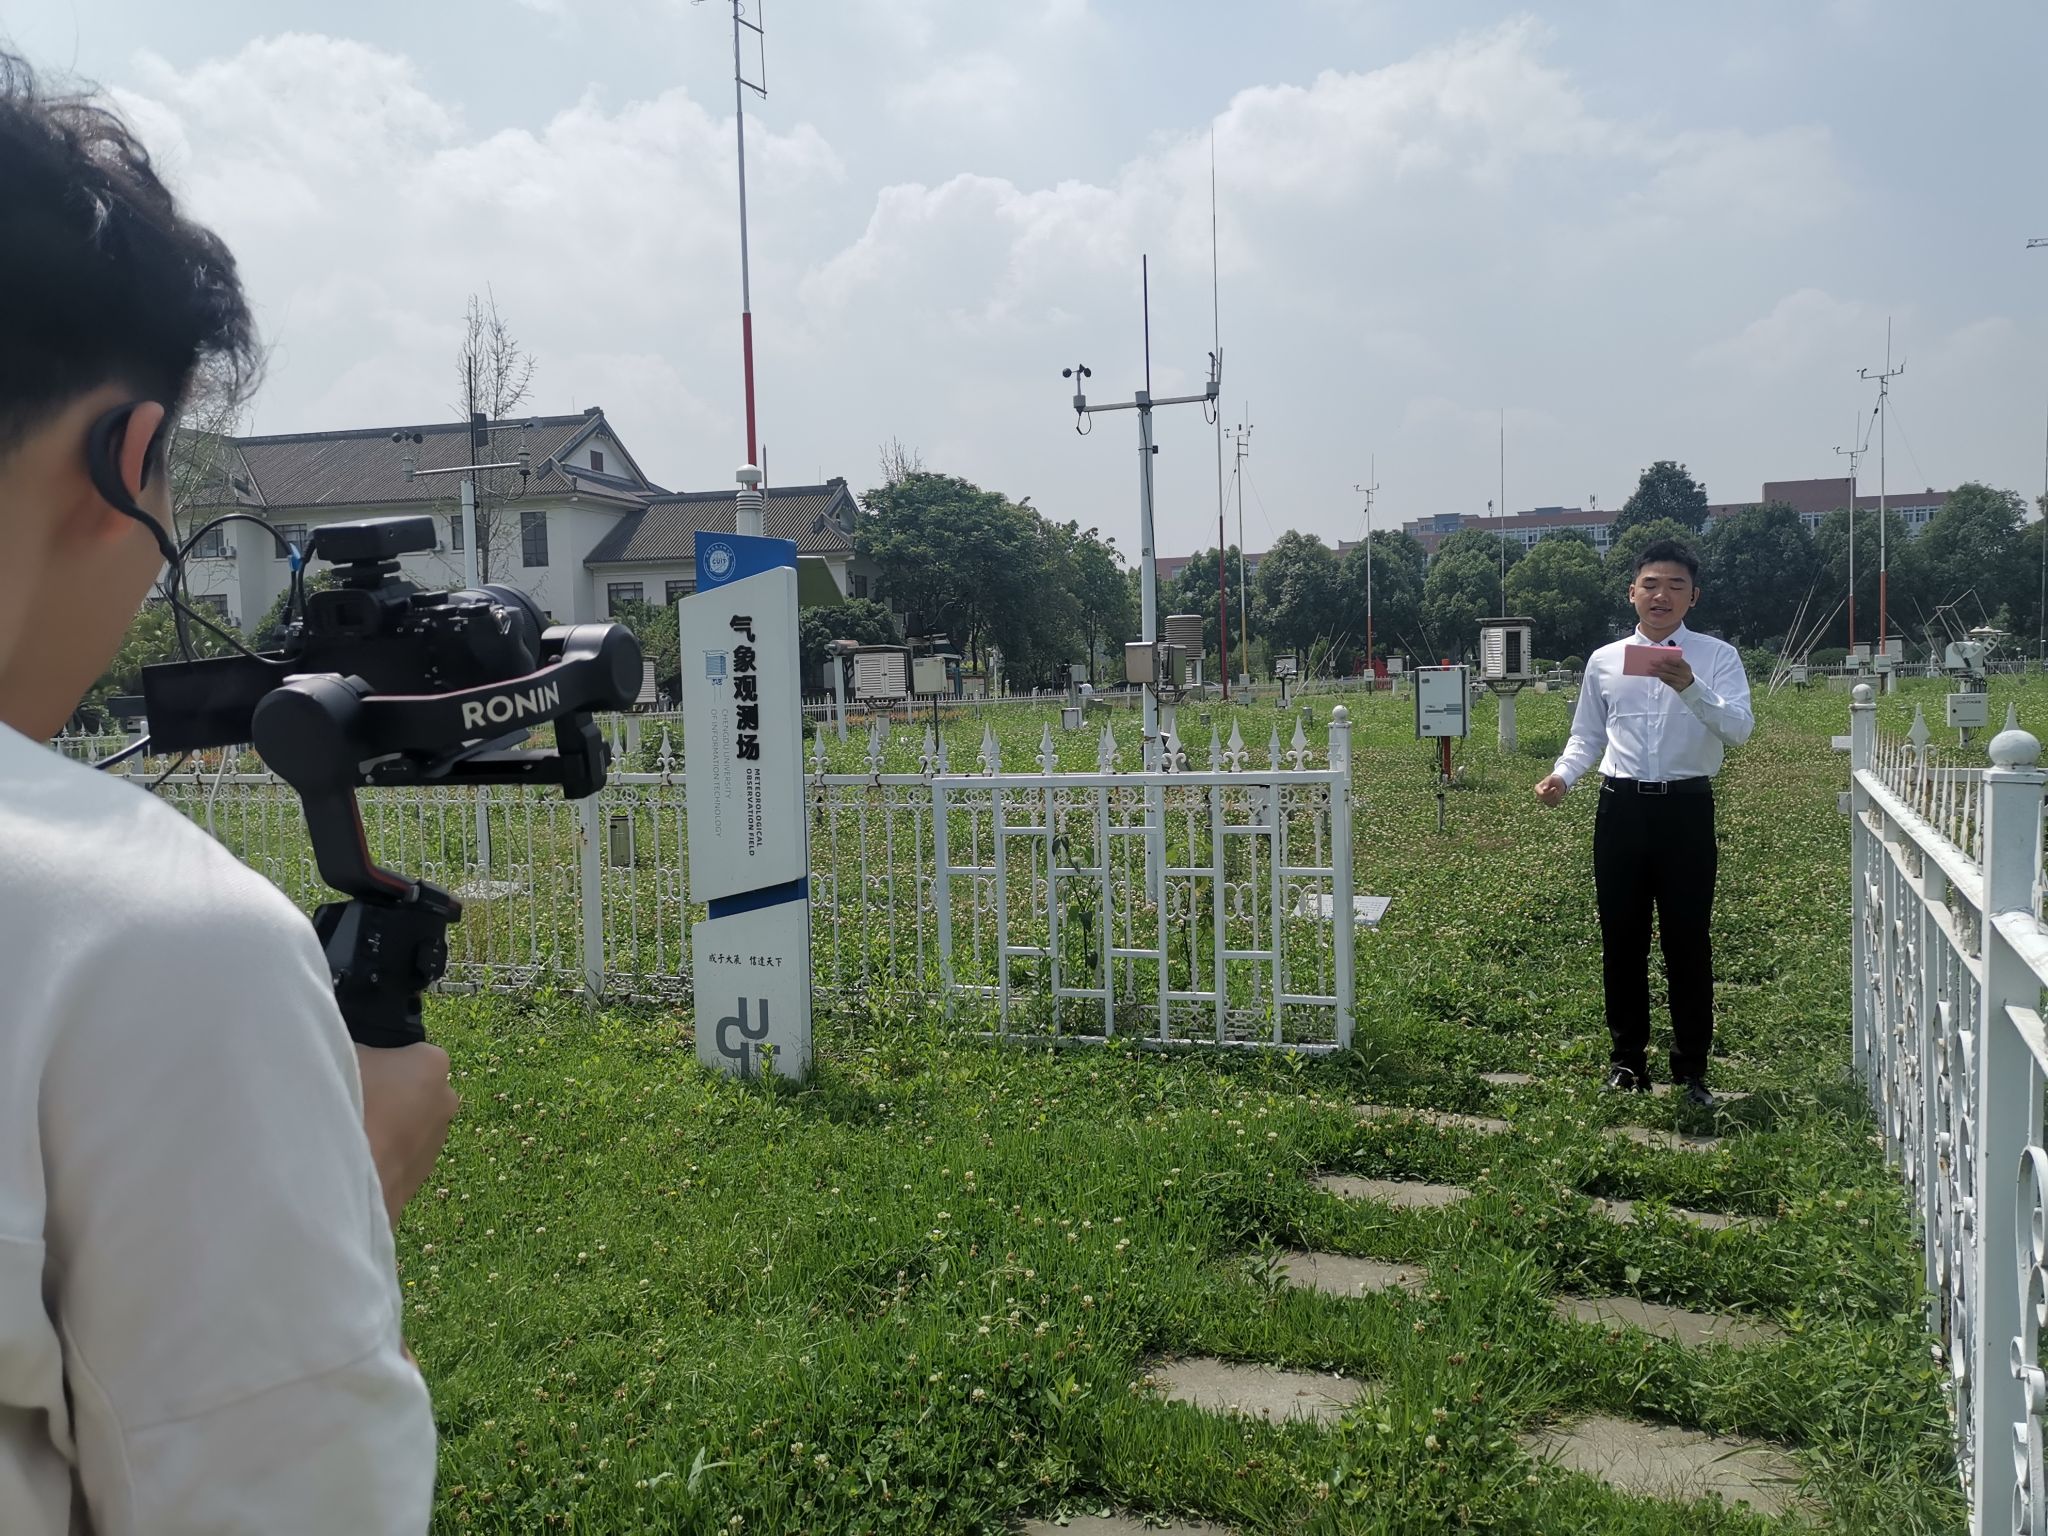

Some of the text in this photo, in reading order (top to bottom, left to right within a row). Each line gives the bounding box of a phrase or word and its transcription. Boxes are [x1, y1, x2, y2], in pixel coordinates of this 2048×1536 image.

[462, 681, 560, 730] RONIN
[730, 614, 760, 761] 气象观测场
[711, 708, 722, 838] OF INFORMATION TECHNOLOGY
[723, 751, 732, 800] UNIVERSITY
[746, 768, 755, 831] OBSERVATION
[755, 768, 763, 847] METEOROLOGICAL
